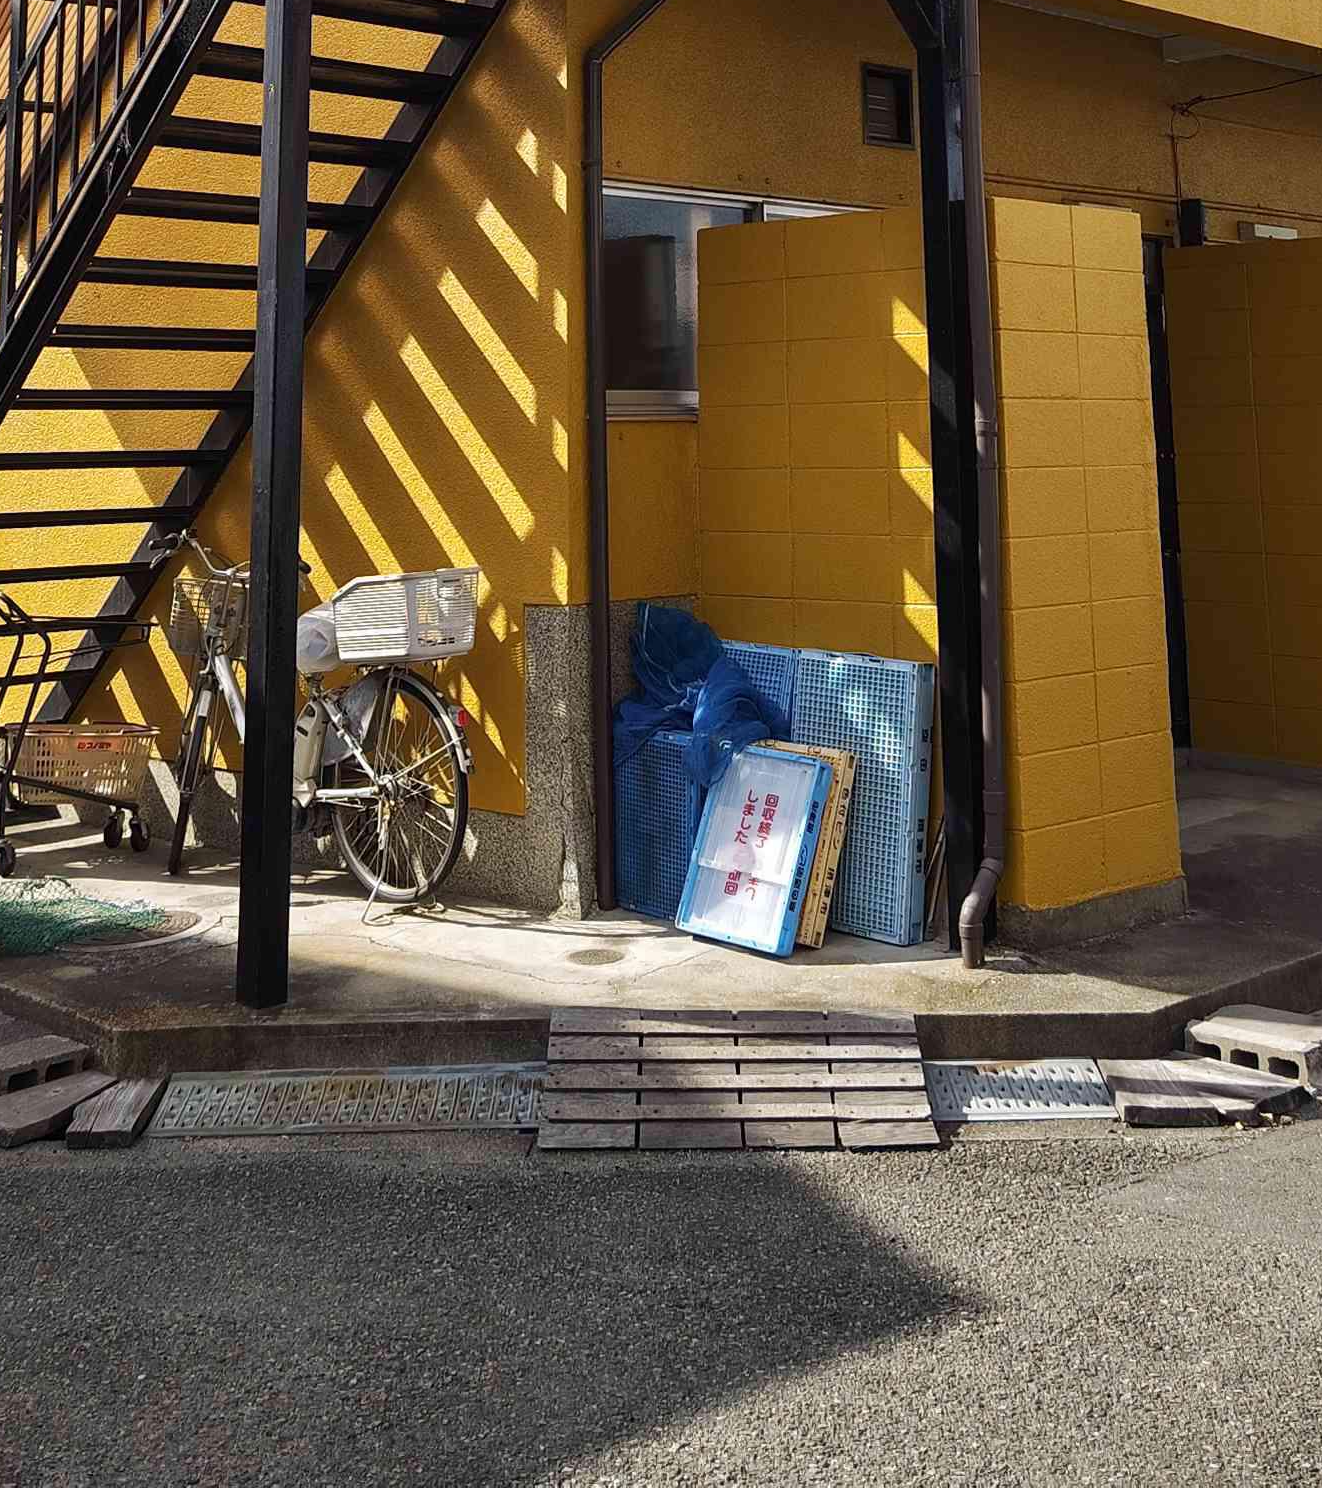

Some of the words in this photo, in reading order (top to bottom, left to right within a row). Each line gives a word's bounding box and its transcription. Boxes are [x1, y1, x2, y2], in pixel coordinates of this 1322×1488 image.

[734, 788, 759, 845] しました
[755, 792, 780, 849] 回収終了
